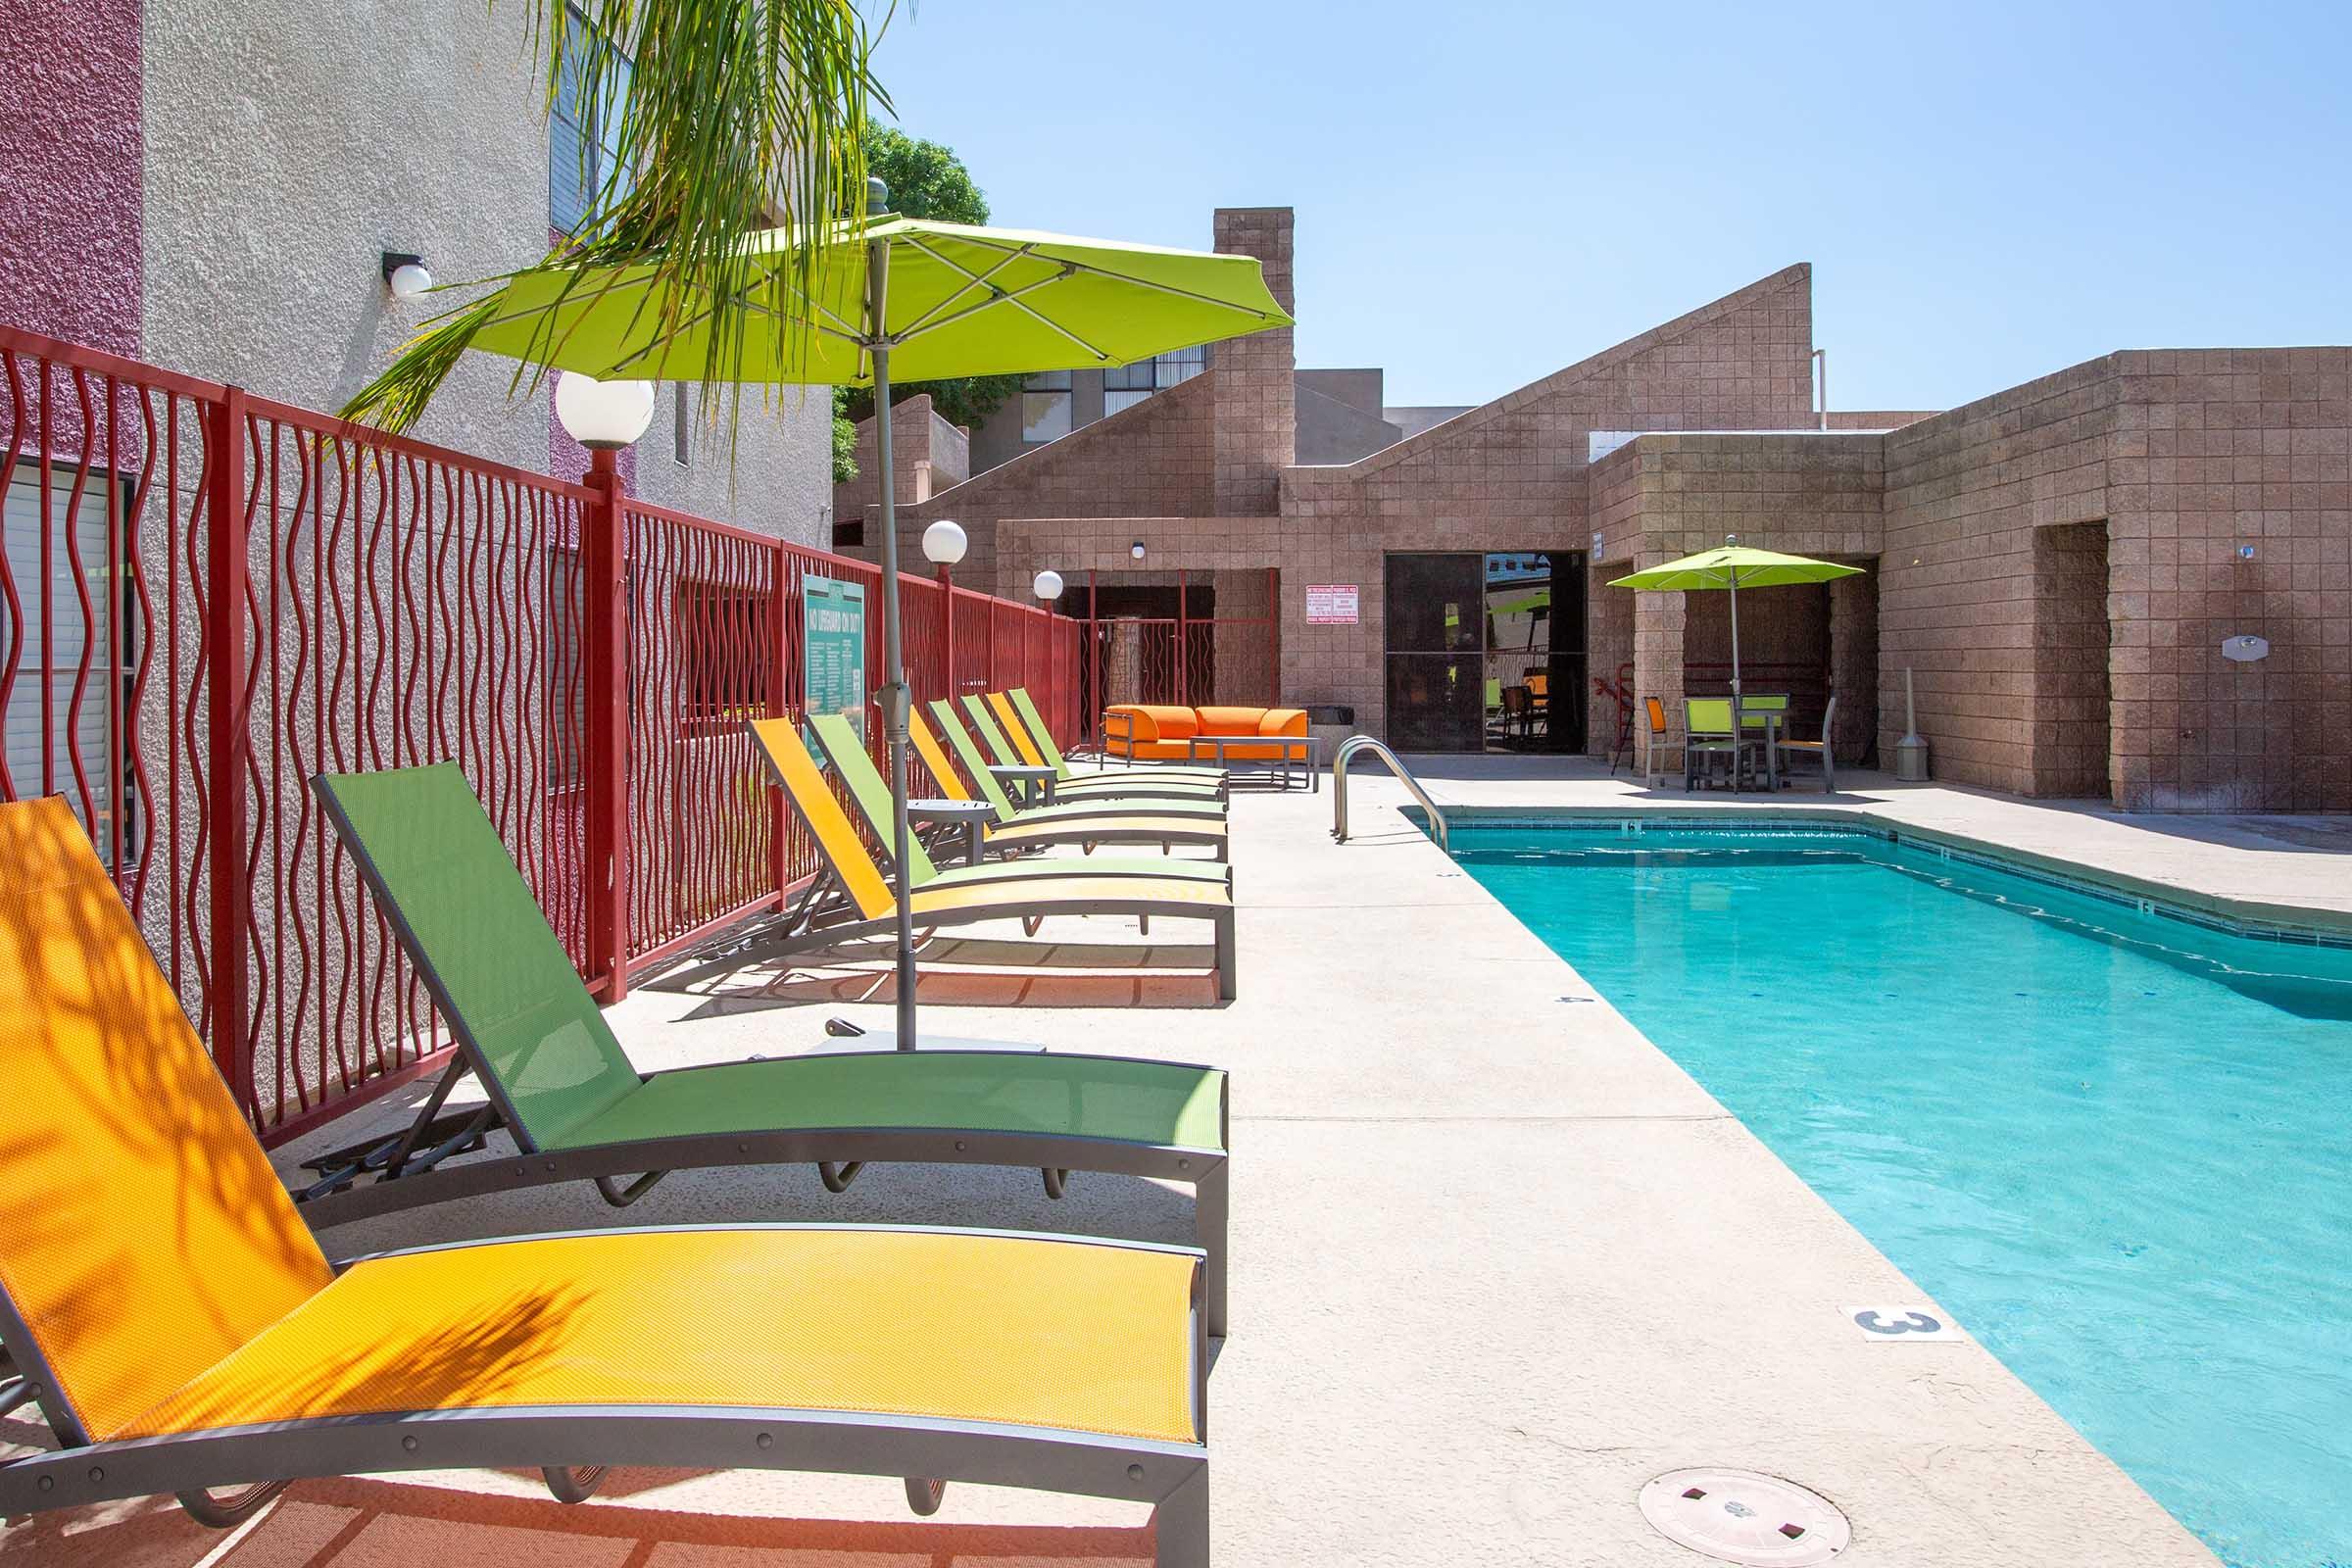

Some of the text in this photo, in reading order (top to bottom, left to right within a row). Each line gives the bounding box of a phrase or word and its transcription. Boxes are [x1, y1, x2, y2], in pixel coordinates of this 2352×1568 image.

[808, 609, 816, 631] NO
[842, 612, 849, 633] ON
[1628, 821, 1635, 831] 6
[1854, 1310, 1941, 1335] 3
